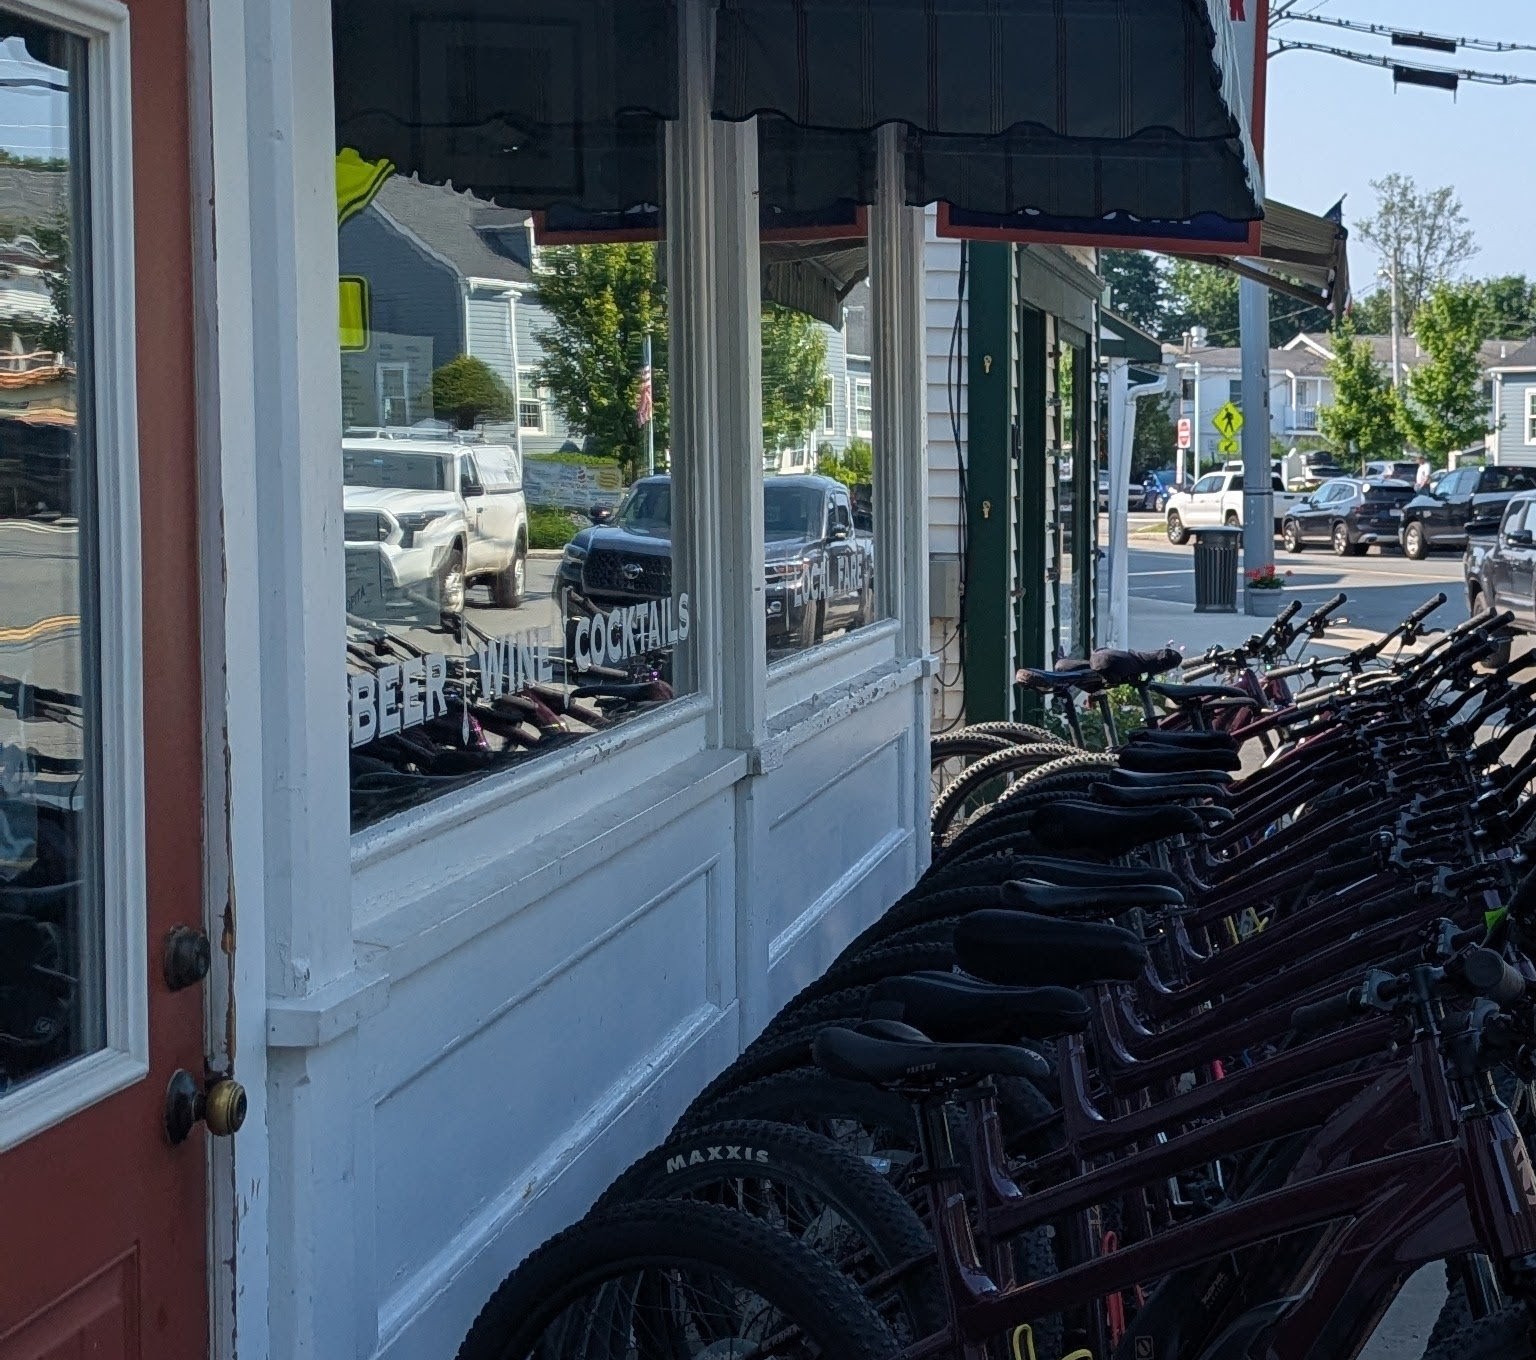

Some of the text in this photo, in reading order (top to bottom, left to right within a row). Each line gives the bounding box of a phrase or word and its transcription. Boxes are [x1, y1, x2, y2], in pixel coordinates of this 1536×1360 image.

[794, 551, 834, 608] LOCAL
[350, 593, 690, 748] BEER WINE COCKTAILS
[666, 1145, 769, 1174] MAXXIS
